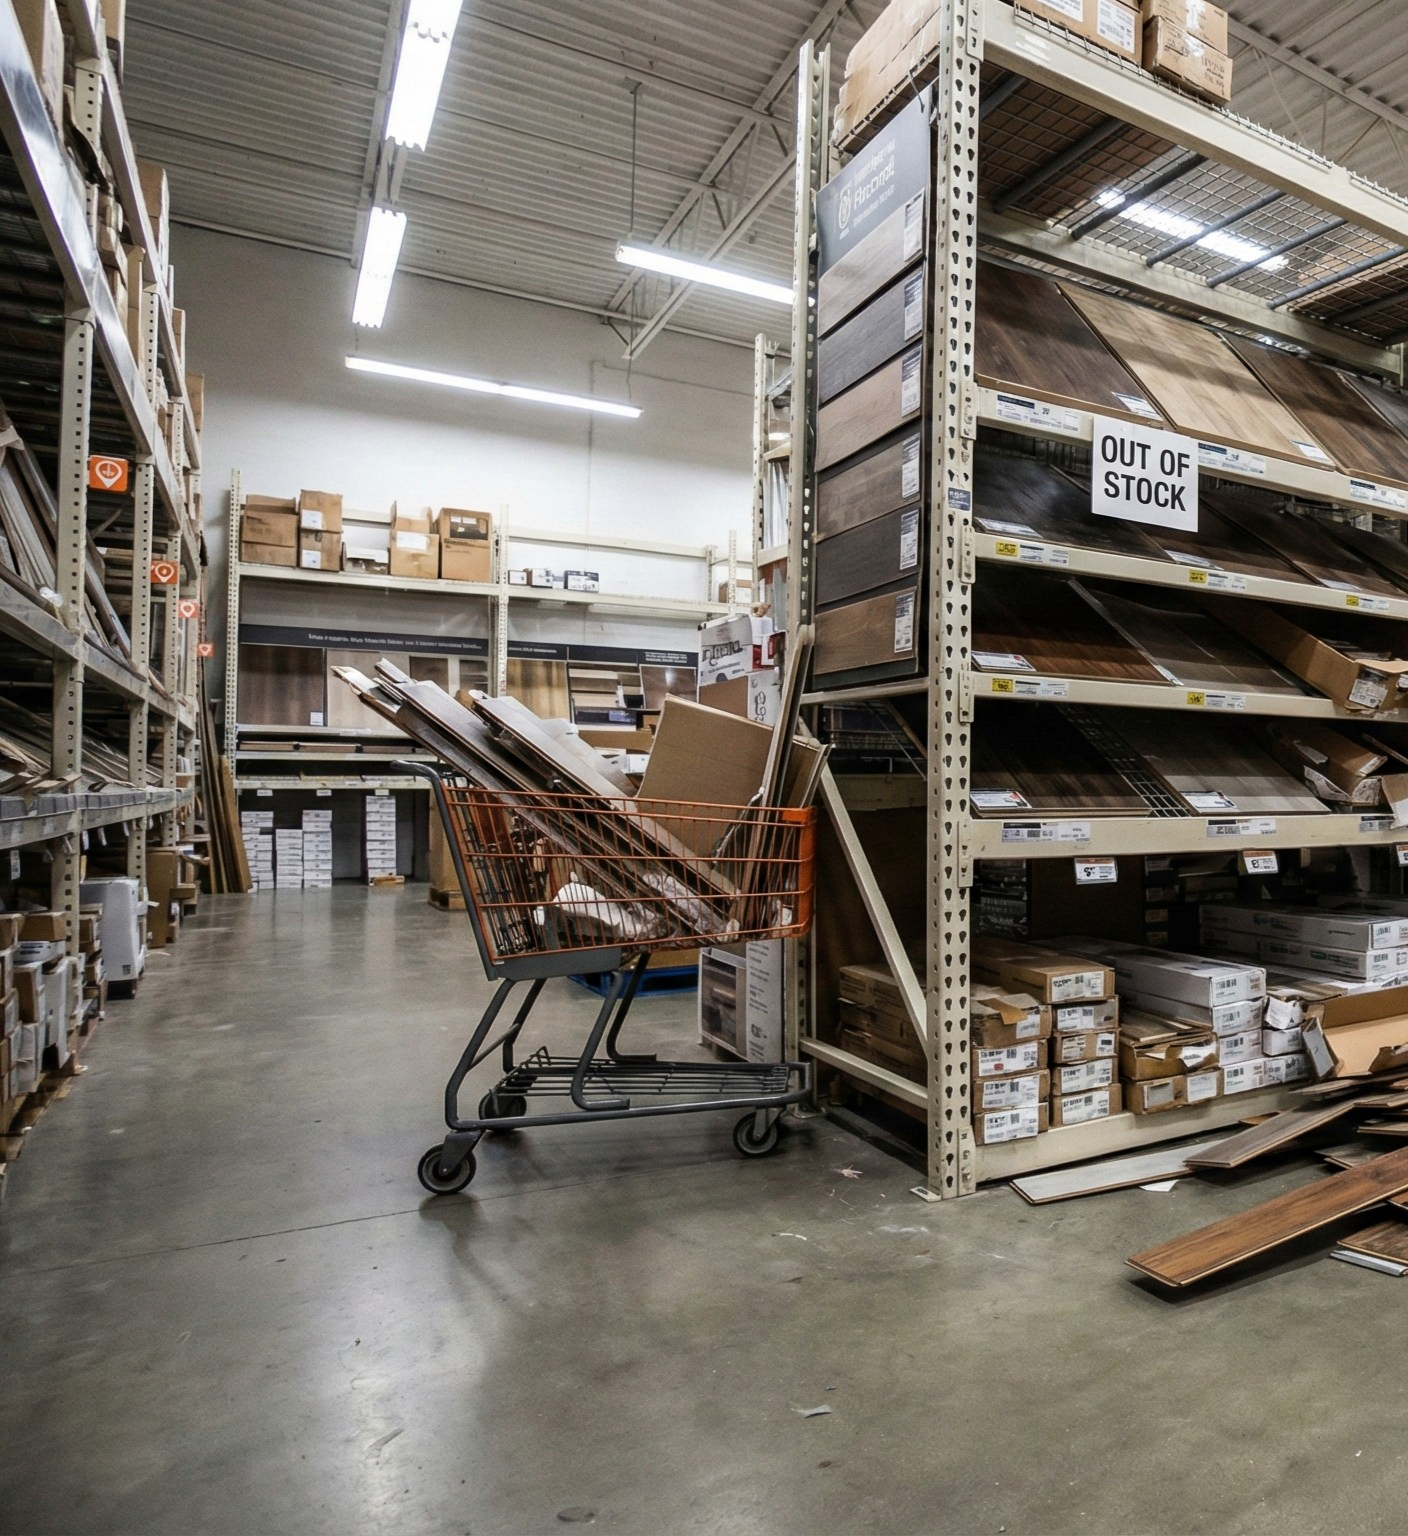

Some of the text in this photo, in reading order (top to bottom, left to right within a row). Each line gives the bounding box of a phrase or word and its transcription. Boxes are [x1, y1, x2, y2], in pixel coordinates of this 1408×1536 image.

[1101, 434, 1191, 478] OUT OF
[1103, 470, 1187, 512] STOCK
